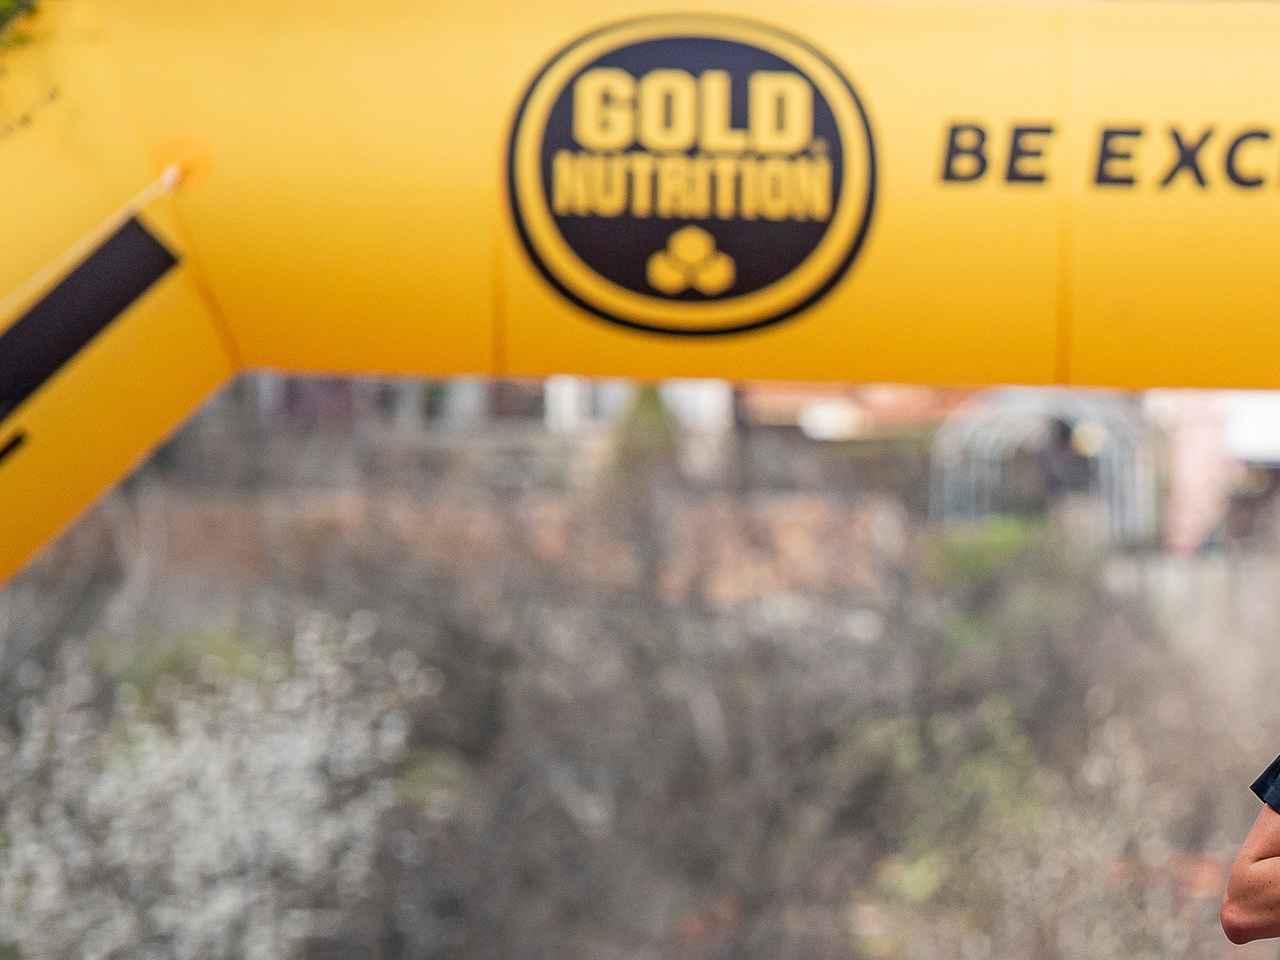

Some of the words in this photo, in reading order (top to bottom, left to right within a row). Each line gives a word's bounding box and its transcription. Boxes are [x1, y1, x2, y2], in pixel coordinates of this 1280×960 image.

[573, 67, 814, 152] GOLD
[552, 149, 833, 222] NUTRITION
[941, 123, 1055, 185] BE
